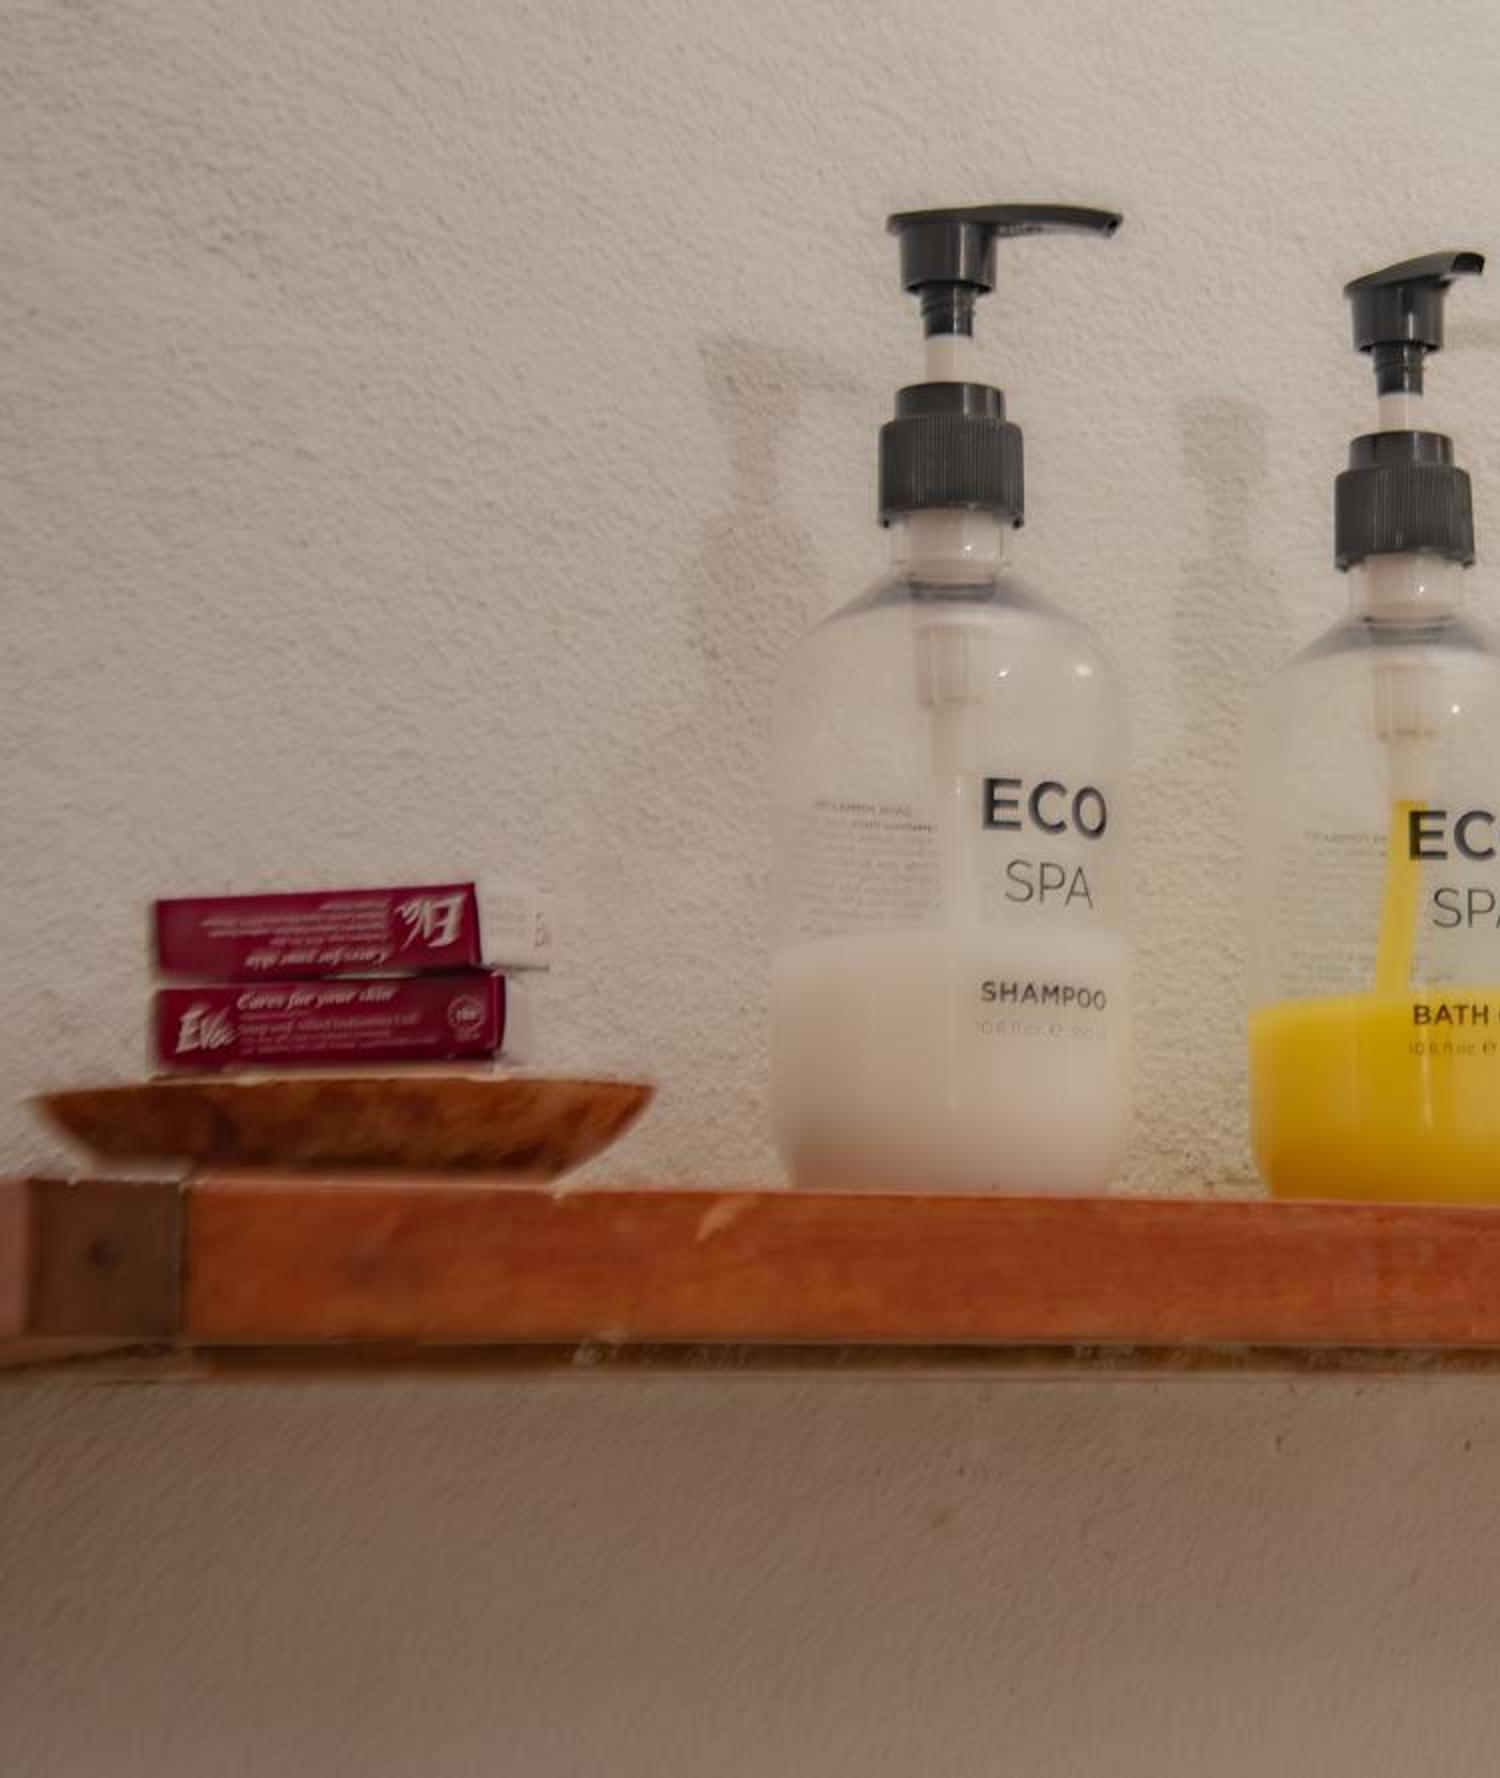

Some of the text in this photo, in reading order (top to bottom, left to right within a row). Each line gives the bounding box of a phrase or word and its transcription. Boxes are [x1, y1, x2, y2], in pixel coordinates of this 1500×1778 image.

[981, 776, 1108, 841] ECO
[1003, 858, 1094, 910] SPA
[979, 980, 1108, 1011] SHAMPOO
[1413, 1003, 1489, 1027] BATH
